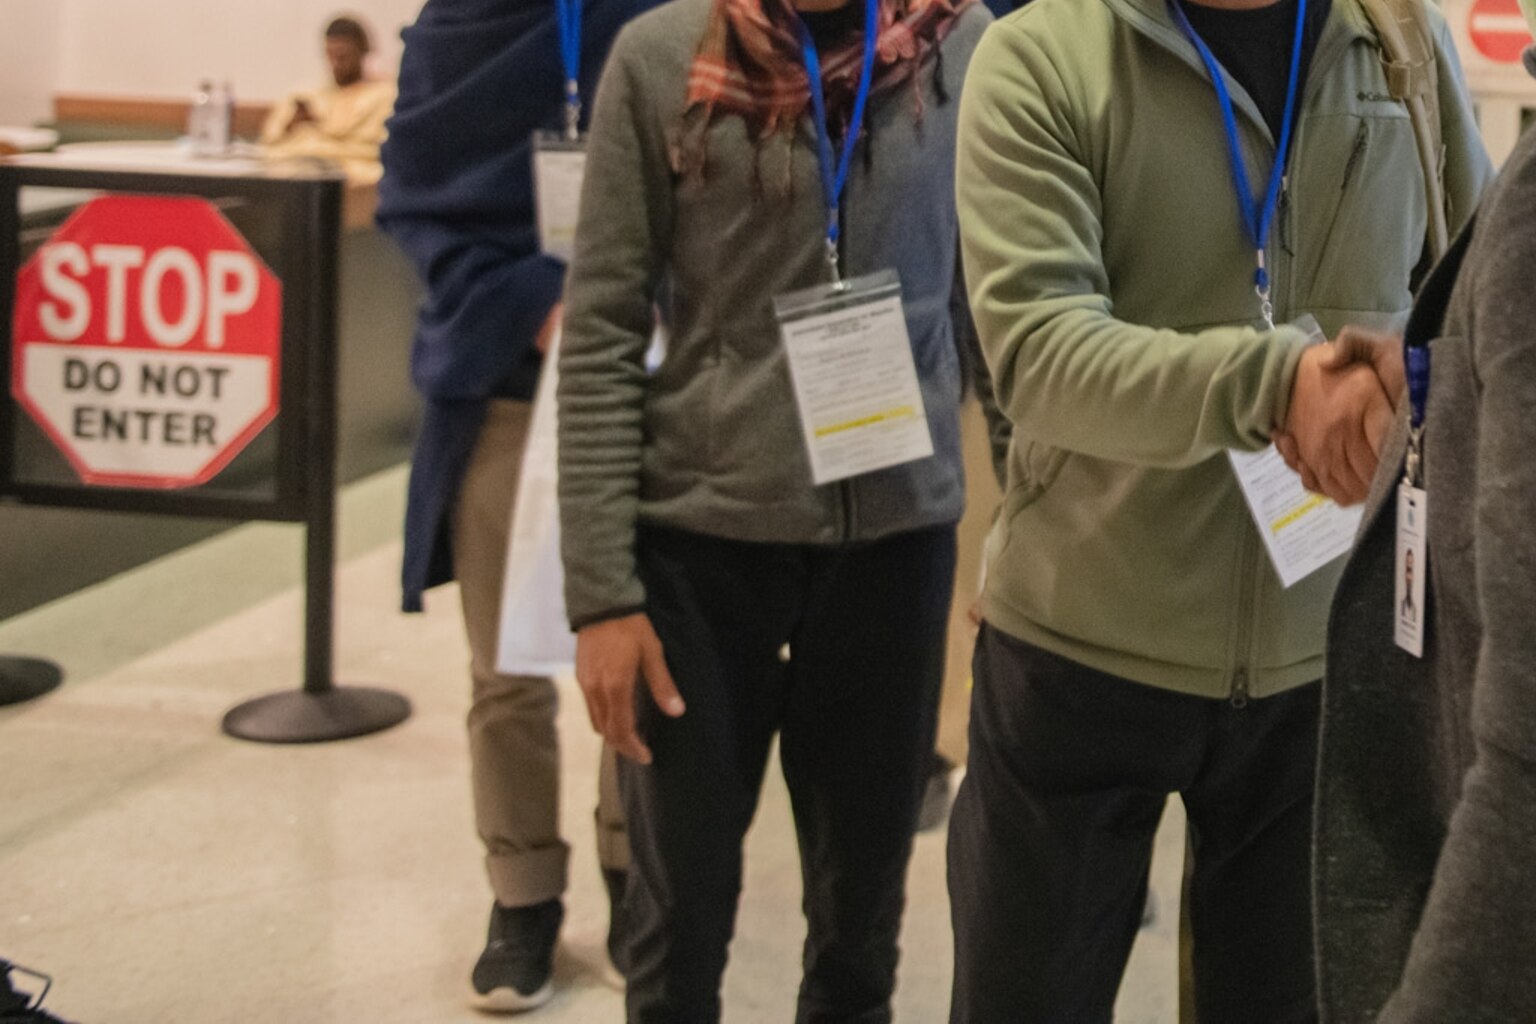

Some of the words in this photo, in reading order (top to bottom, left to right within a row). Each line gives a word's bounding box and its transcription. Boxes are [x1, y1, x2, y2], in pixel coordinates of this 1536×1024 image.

[38, 241, 260, 349] STOP
[63, 358, 123, 394] DO
[141, 363, 230, 399] NOT
[73, 407, 218, 446] ENTER
